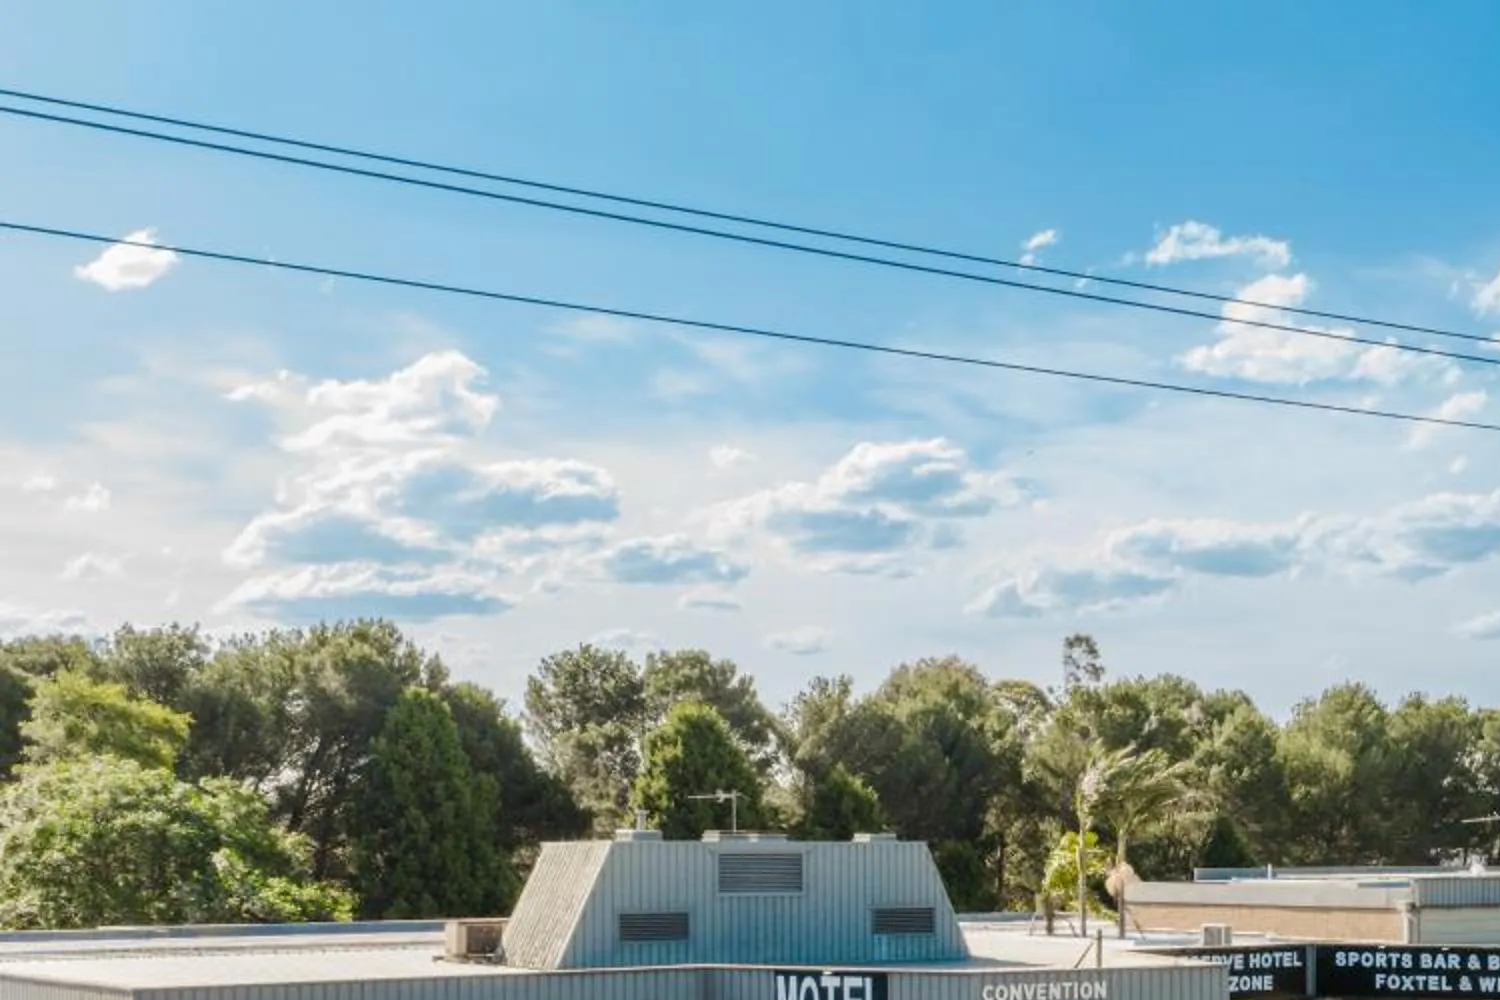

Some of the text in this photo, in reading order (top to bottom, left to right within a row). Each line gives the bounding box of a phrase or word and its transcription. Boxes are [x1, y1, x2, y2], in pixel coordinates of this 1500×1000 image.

[1249, 951, 1303, 969] HOTEL
[1335, 951, 1413, 968] SPORTS
[1420, 953, 1461, 970] BAR
[1467, 954, 1481, 970] &
[1229, 975, 1275, 992] ZONE
[1375, 973, 1453, 991] FOXTEL
[1459, 977, 1473, 992] &
